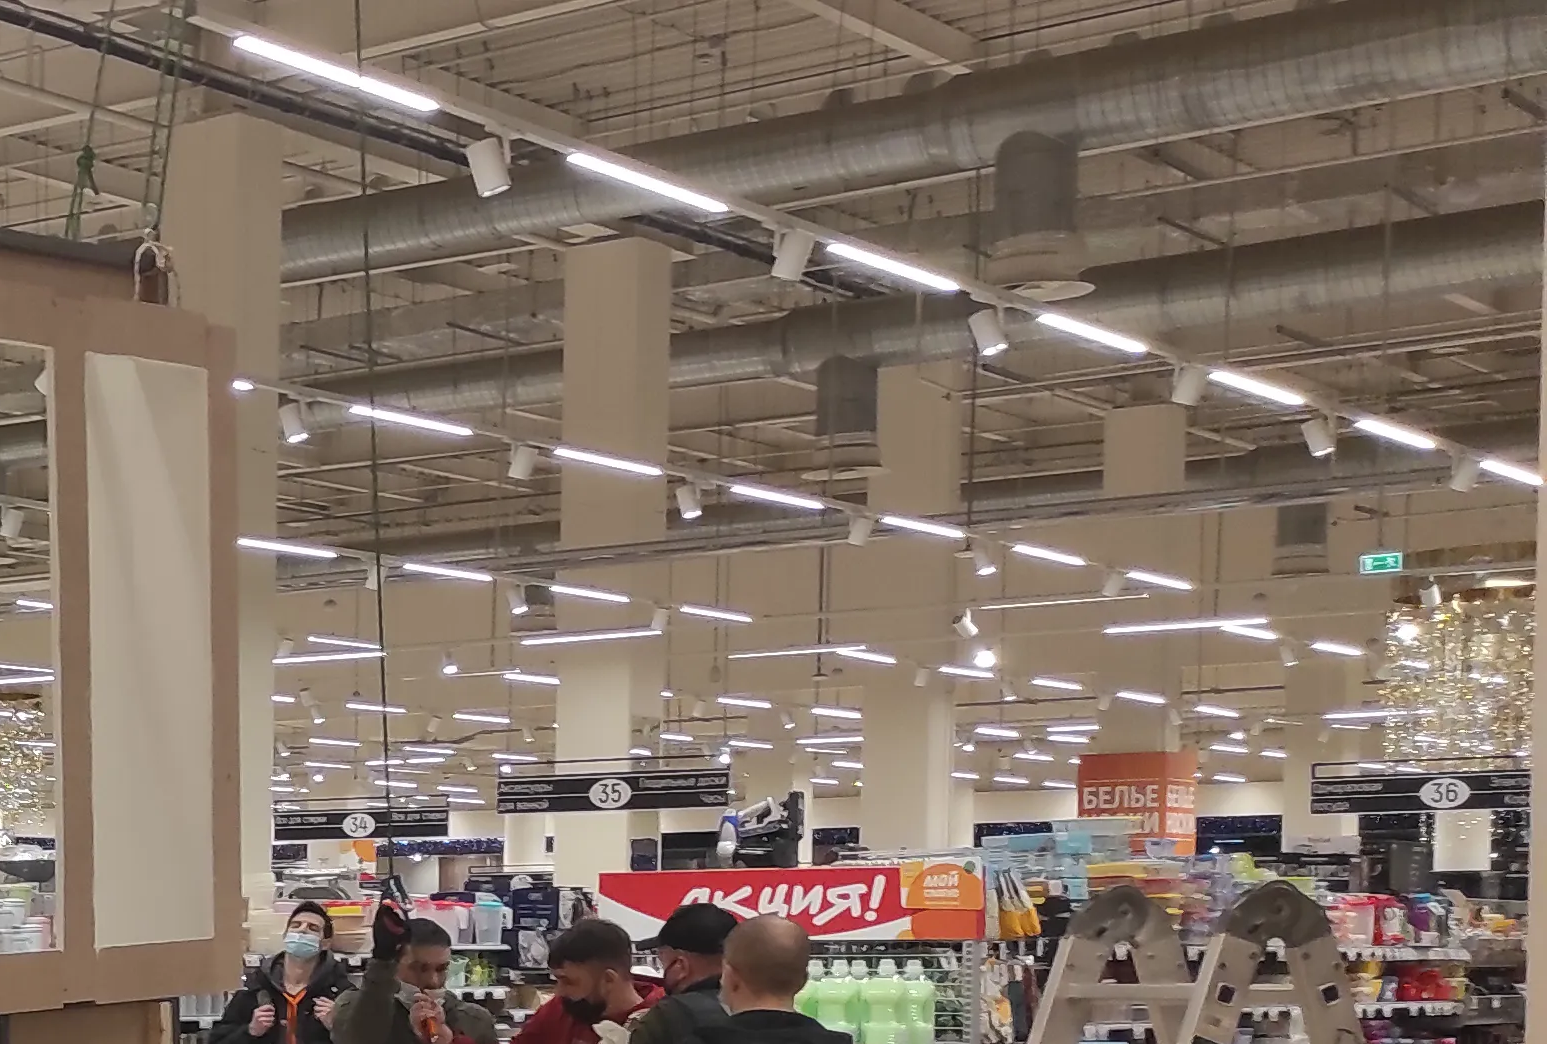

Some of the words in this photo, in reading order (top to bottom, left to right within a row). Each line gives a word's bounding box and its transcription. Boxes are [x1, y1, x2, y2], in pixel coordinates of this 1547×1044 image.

[597, 782, 623, 803] 35
[1082, 784, 1160, 810] БЕЛЬЕ
[1429, 782, 1460, 803] 36
[349, 816, 369, 834] 34
